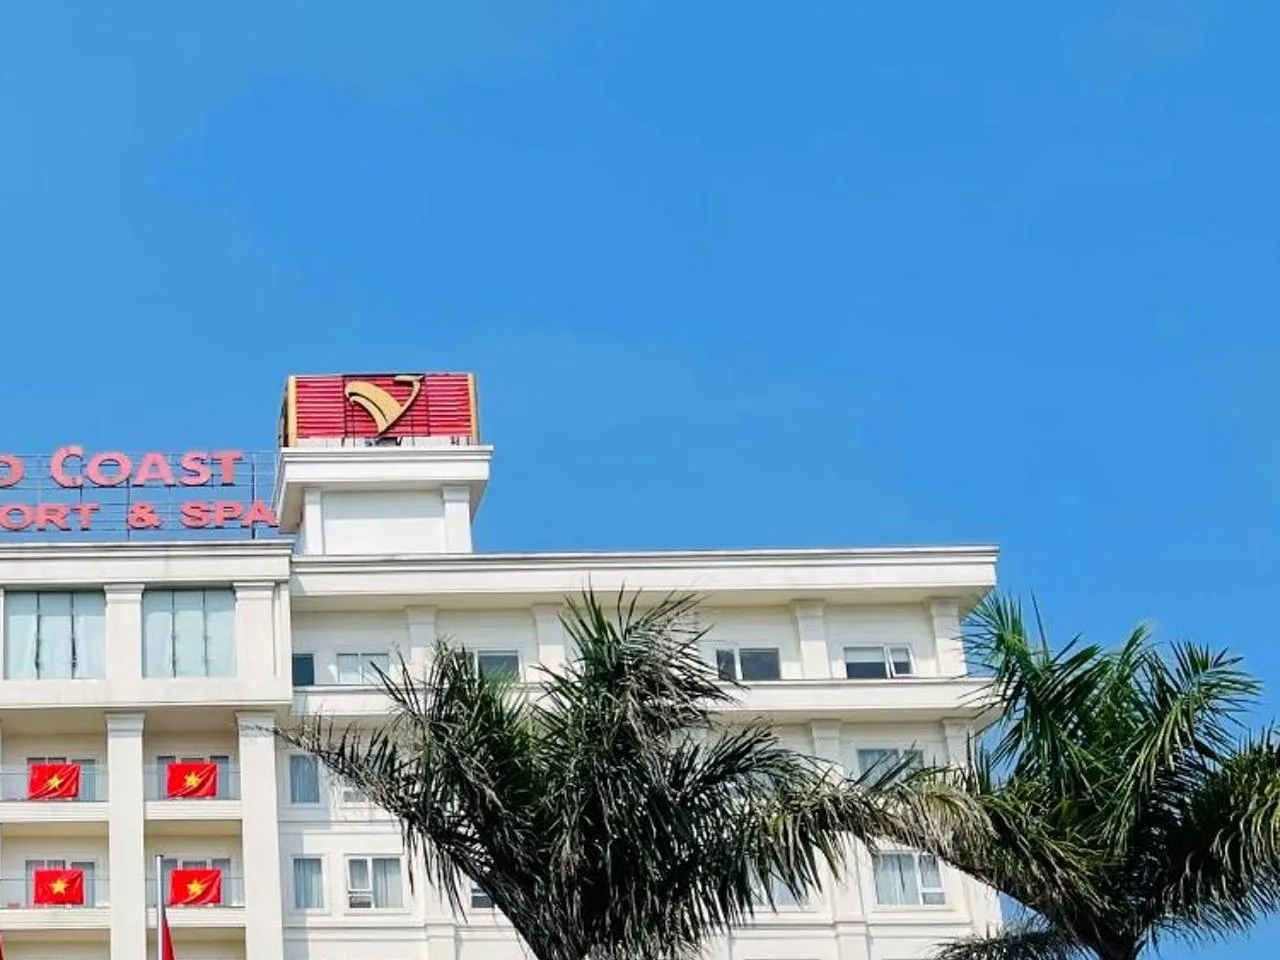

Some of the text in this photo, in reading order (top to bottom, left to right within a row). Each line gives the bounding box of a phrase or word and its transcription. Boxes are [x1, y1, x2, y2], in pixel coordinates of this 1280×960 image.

[49, 445, 242, 488] COAST
[126, 500, 163, 529] &
[180, 499, 280, 529] SPA
